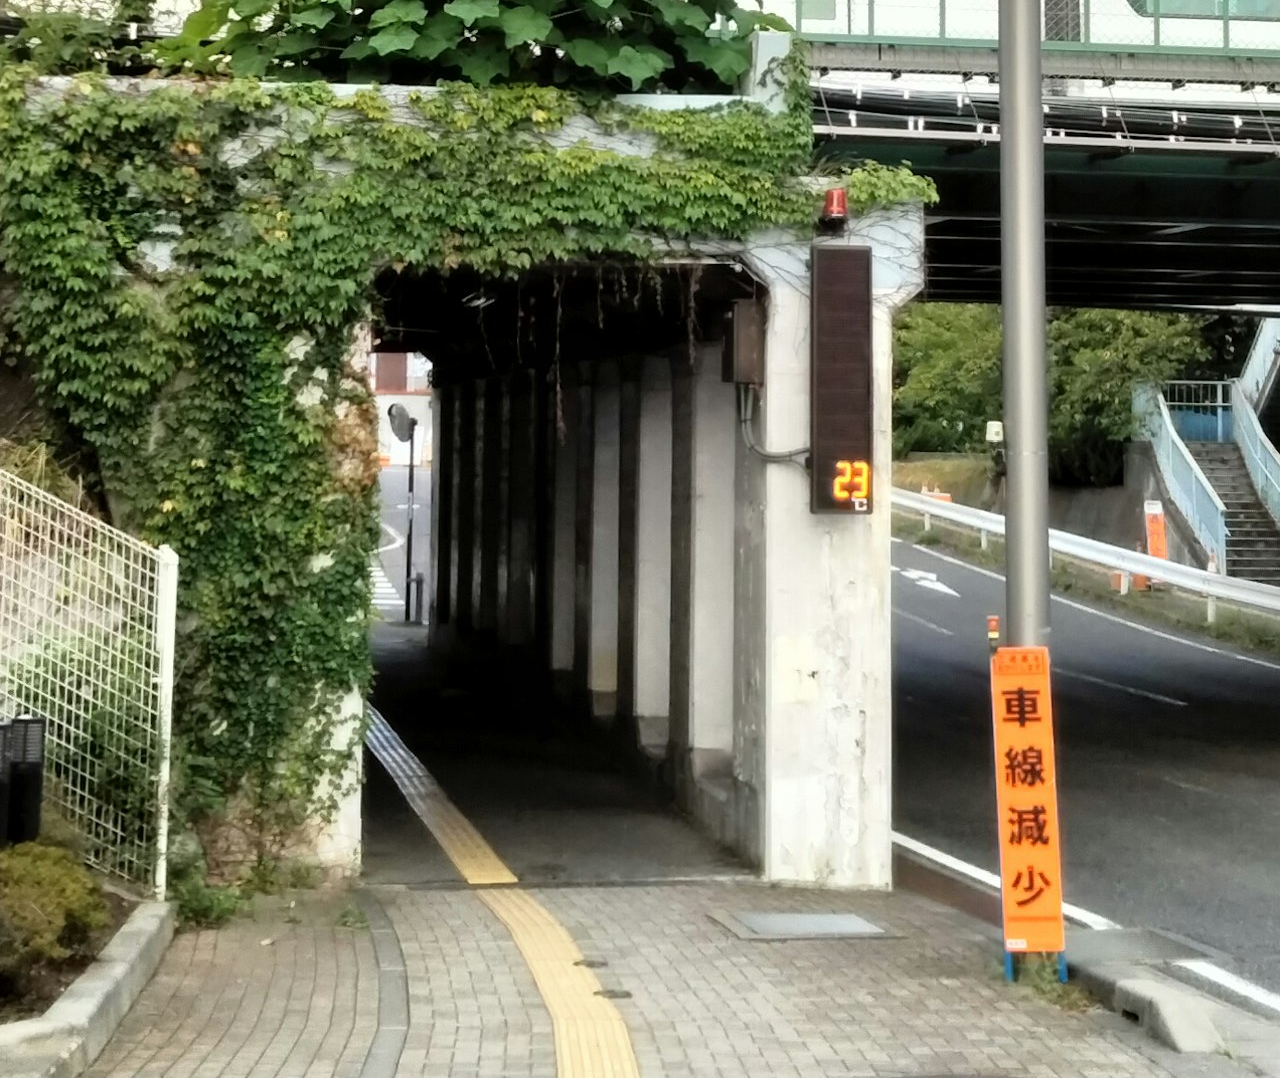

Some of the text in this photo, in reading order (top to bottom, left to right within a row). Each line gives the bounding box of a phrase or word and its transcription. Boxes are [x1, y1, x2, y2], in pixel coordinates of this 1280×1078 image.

[833, 459, 869, 500] 23
[1001, 687, 1051, 908] 車線減少
